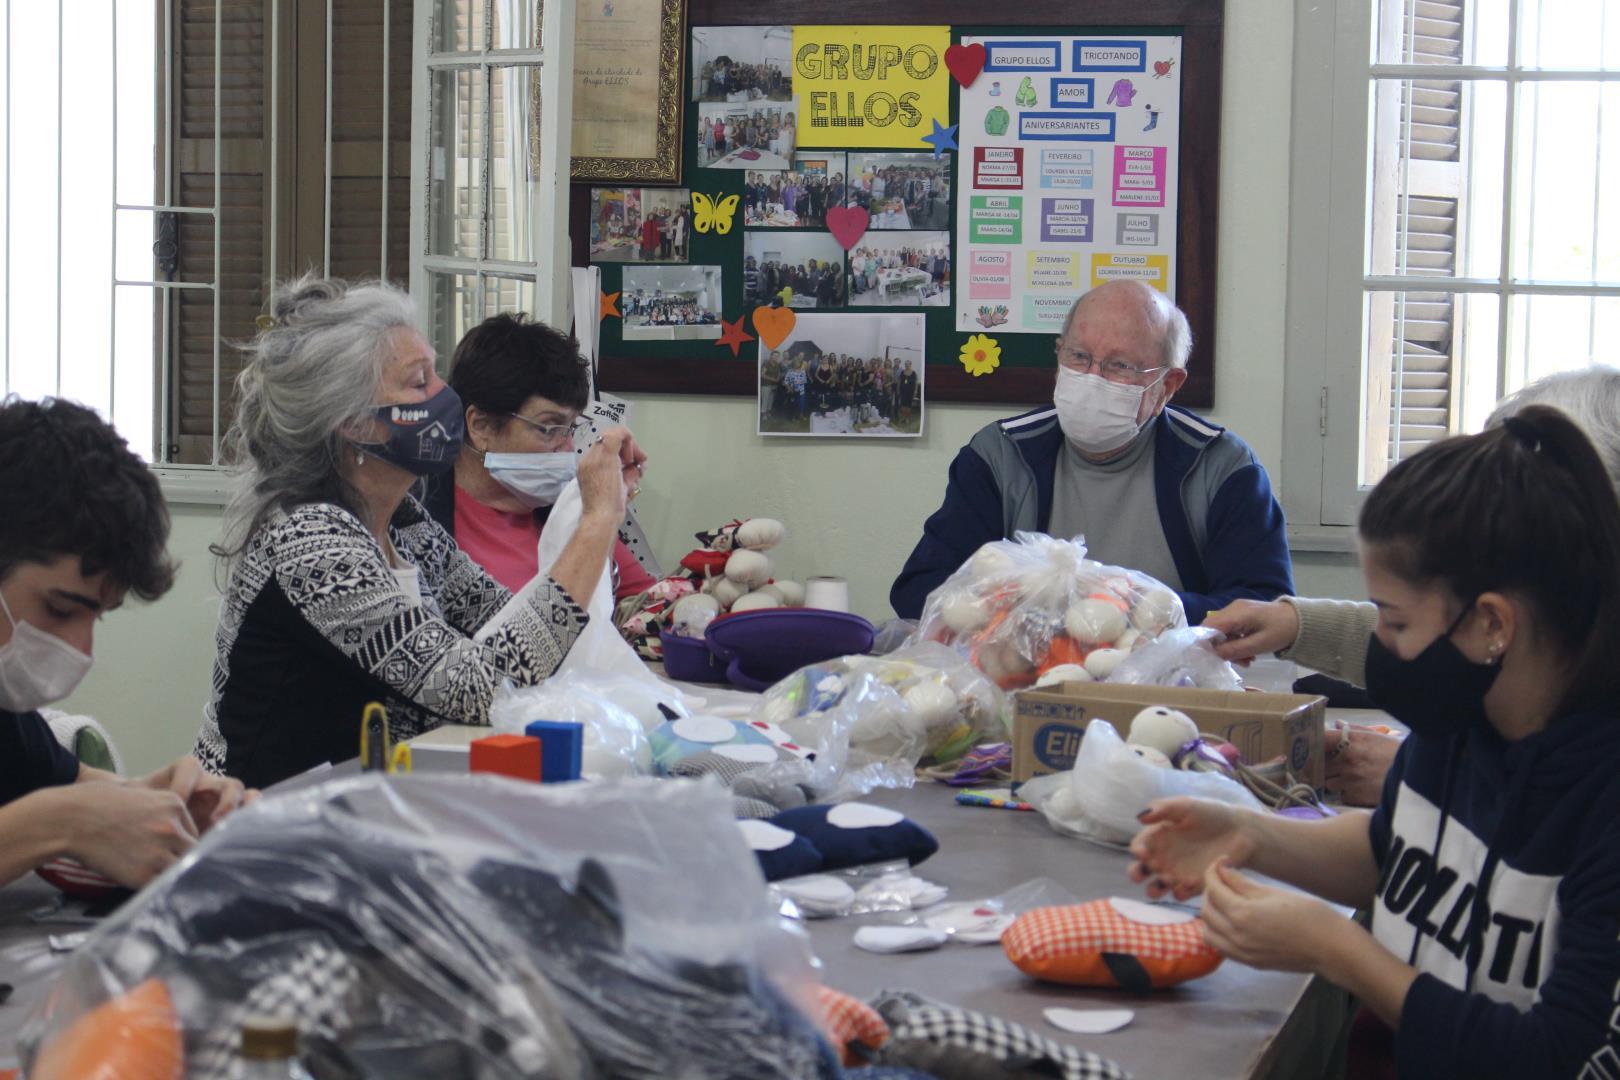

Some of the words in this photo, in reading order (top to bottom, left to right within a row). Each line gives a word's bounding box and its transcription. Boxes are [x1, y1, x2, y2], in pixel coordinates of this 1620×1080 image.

[994, 56, 1024, 65] GRUPO
[1026, 57, 1051, 65] ELLOS
[1084, 52, 1139, 60] TRICOTANDO
[796, 43, 938, 80] GRUPO
[1058, 88, 1085, 97] AMOR
[810, 92, 922, 127] ELLOS
[1024, 121, 1100, 130] ANIVERSARIANTES
[1128, 150, 1152, 158] MARÇO
[1036, 256, 1071, 264] SETEMBRO
[1113, 256, 1146, 264] OUTUBRO
[1045, 729, 1079, 757] Eli
